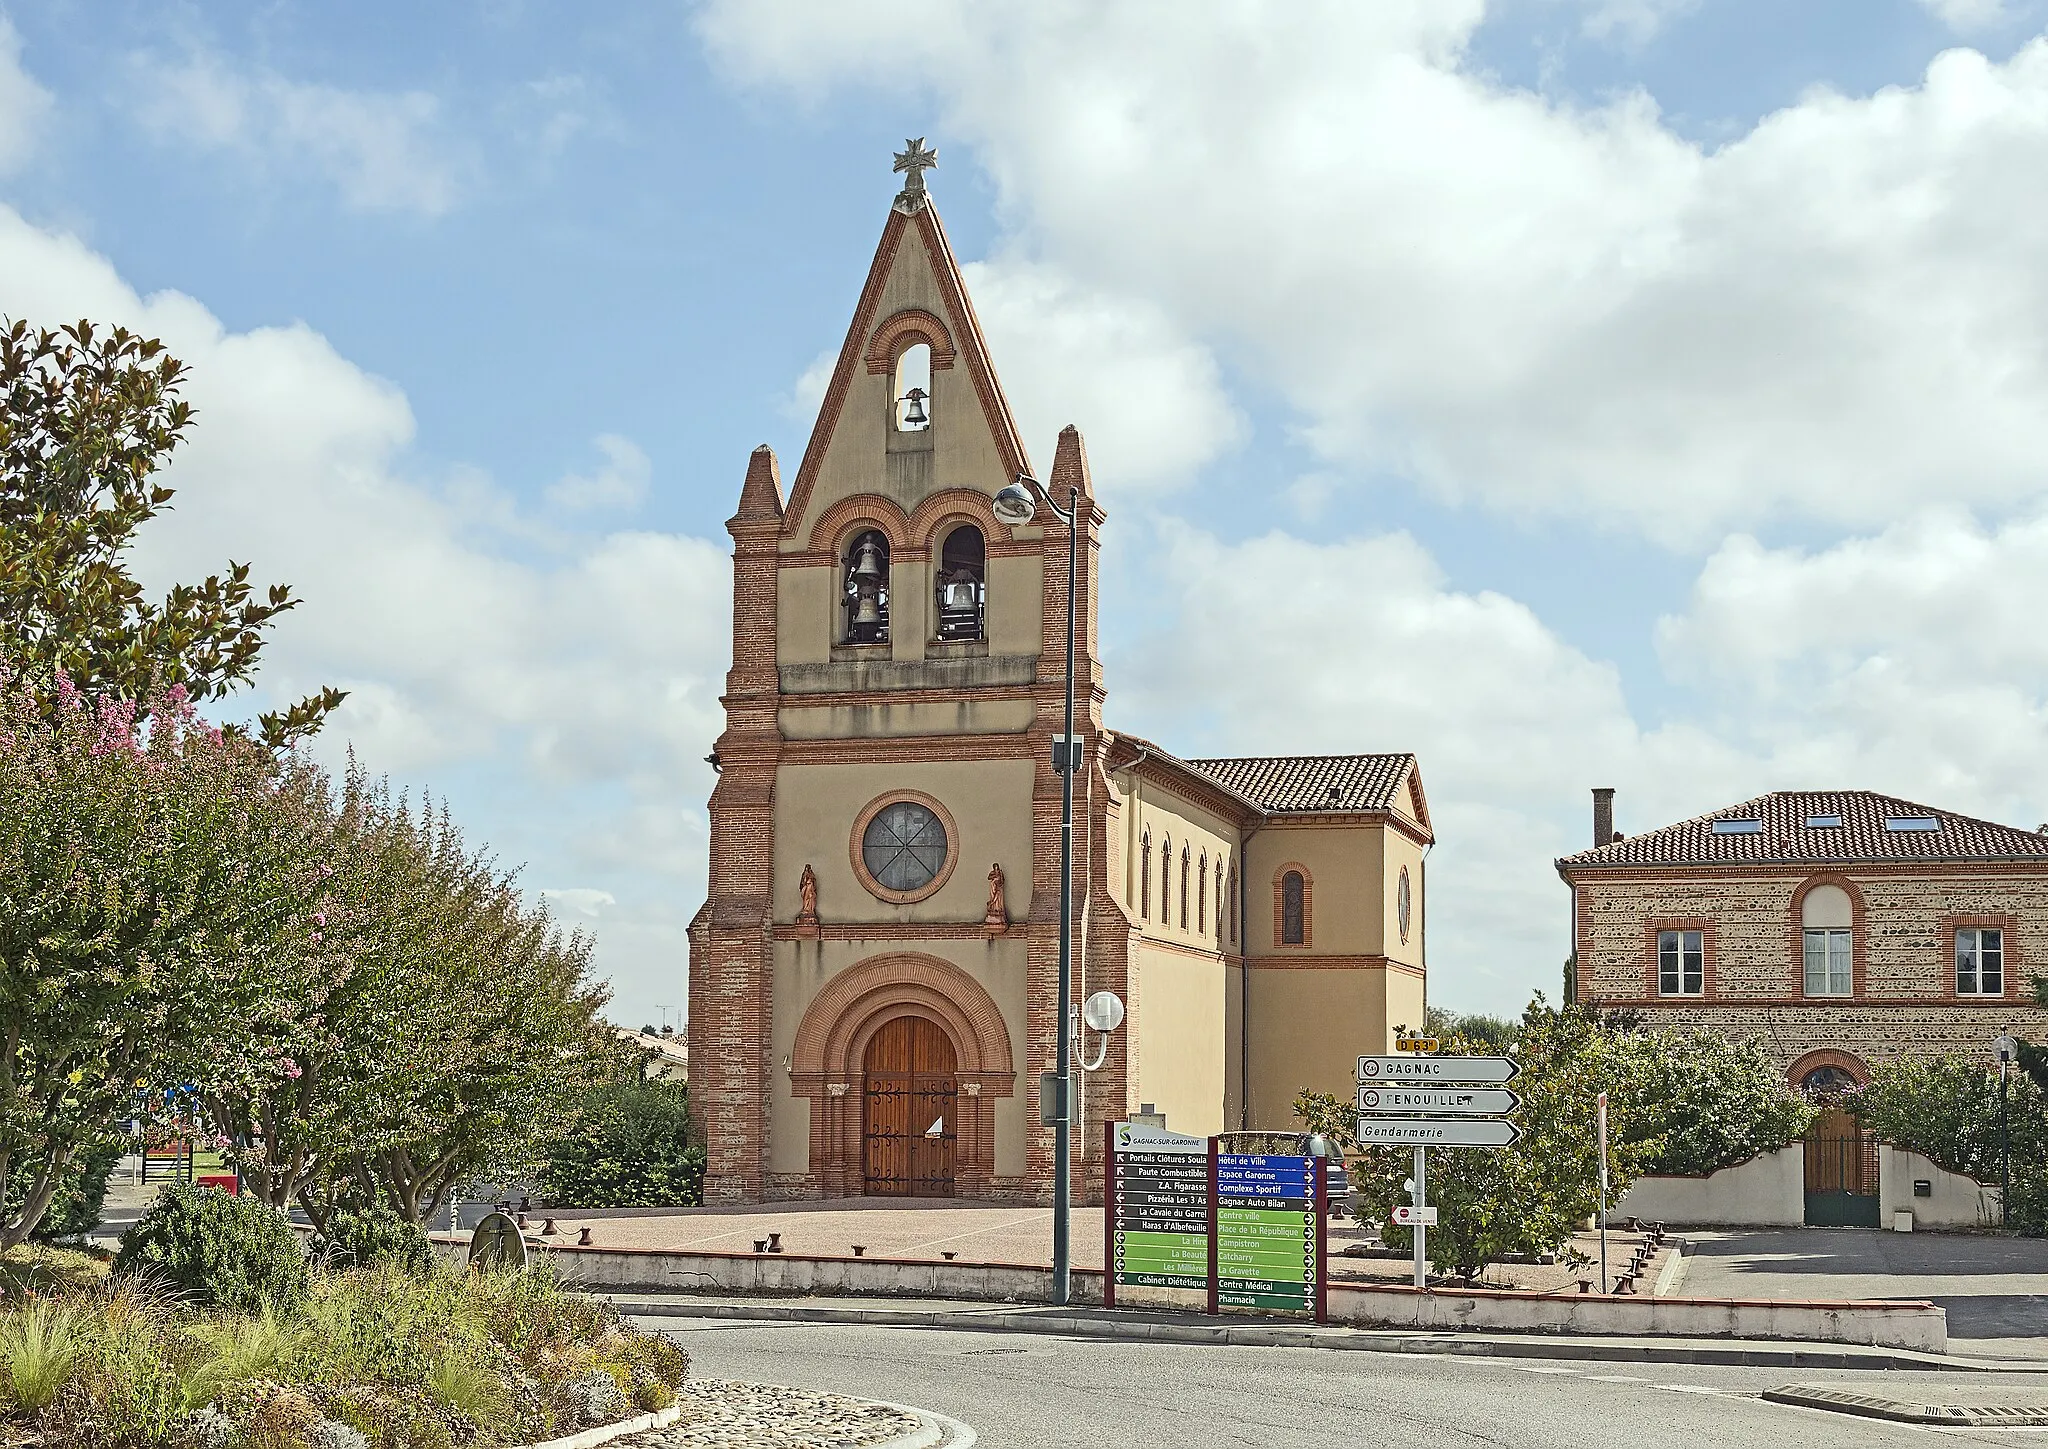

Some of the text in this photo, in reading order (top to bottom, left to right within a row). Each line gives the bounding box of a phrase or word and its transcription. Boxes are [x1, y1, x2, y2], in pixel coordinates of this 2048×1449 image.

[1401, 1041, 1408, 1050] D
[1386, 1063, 1440, 1075] GAGNAC
[1364, 1126, 1443, 1138] Gendarmerie
[1133, 1138, 1200, 1146] GAGNAC-SUR-GARONNE
[1129, 1154, 1207, 1164] Portails Clôtures Soula
[1218, 1156, 1267, 1165] Hôtel de Ville
[1138, 1167, 1207, 1177] Paute Combustibles
[1218, 1170, 1276, 1180] Espace Garonne
[1158, 1182, 1207, 1192] Z.A. Figarasse
[1218, 1184, 1282, 1194] Complexe Sportif
[1147, 1194, 1207, 1204] Pizzéria Les 3 As
[1218, 1197, 1286, 1208] Gagnac Auto Bilan
[1139, 1207, 1207, 1218] La Cavale du Garrel
[1218, 1211, 1260, 1220] Centre ville
[1142, 1221, 1207, 1232] Haras d'Albefeuille
[1218, 1225, 1299, 1237] Place de la République
[1192, 1237, 1207, 1246] Hire
[1218, 1238, 1260, 1248] Campistron
[1182, 1250, 1207, 1259] Beauté
[1218, 1252, 1254, 1263] Catcharry
[1163, 1263, 1175, 1271] Les
[1218, 1266, 1260, 1276] La Gravette
[1137, 1275, 1207, 1288] Cabinet Diététique
[1218, 1280, 1273, 1291] Centre Médical
[1218, 1294, 1256, 1304] Pharmacie
